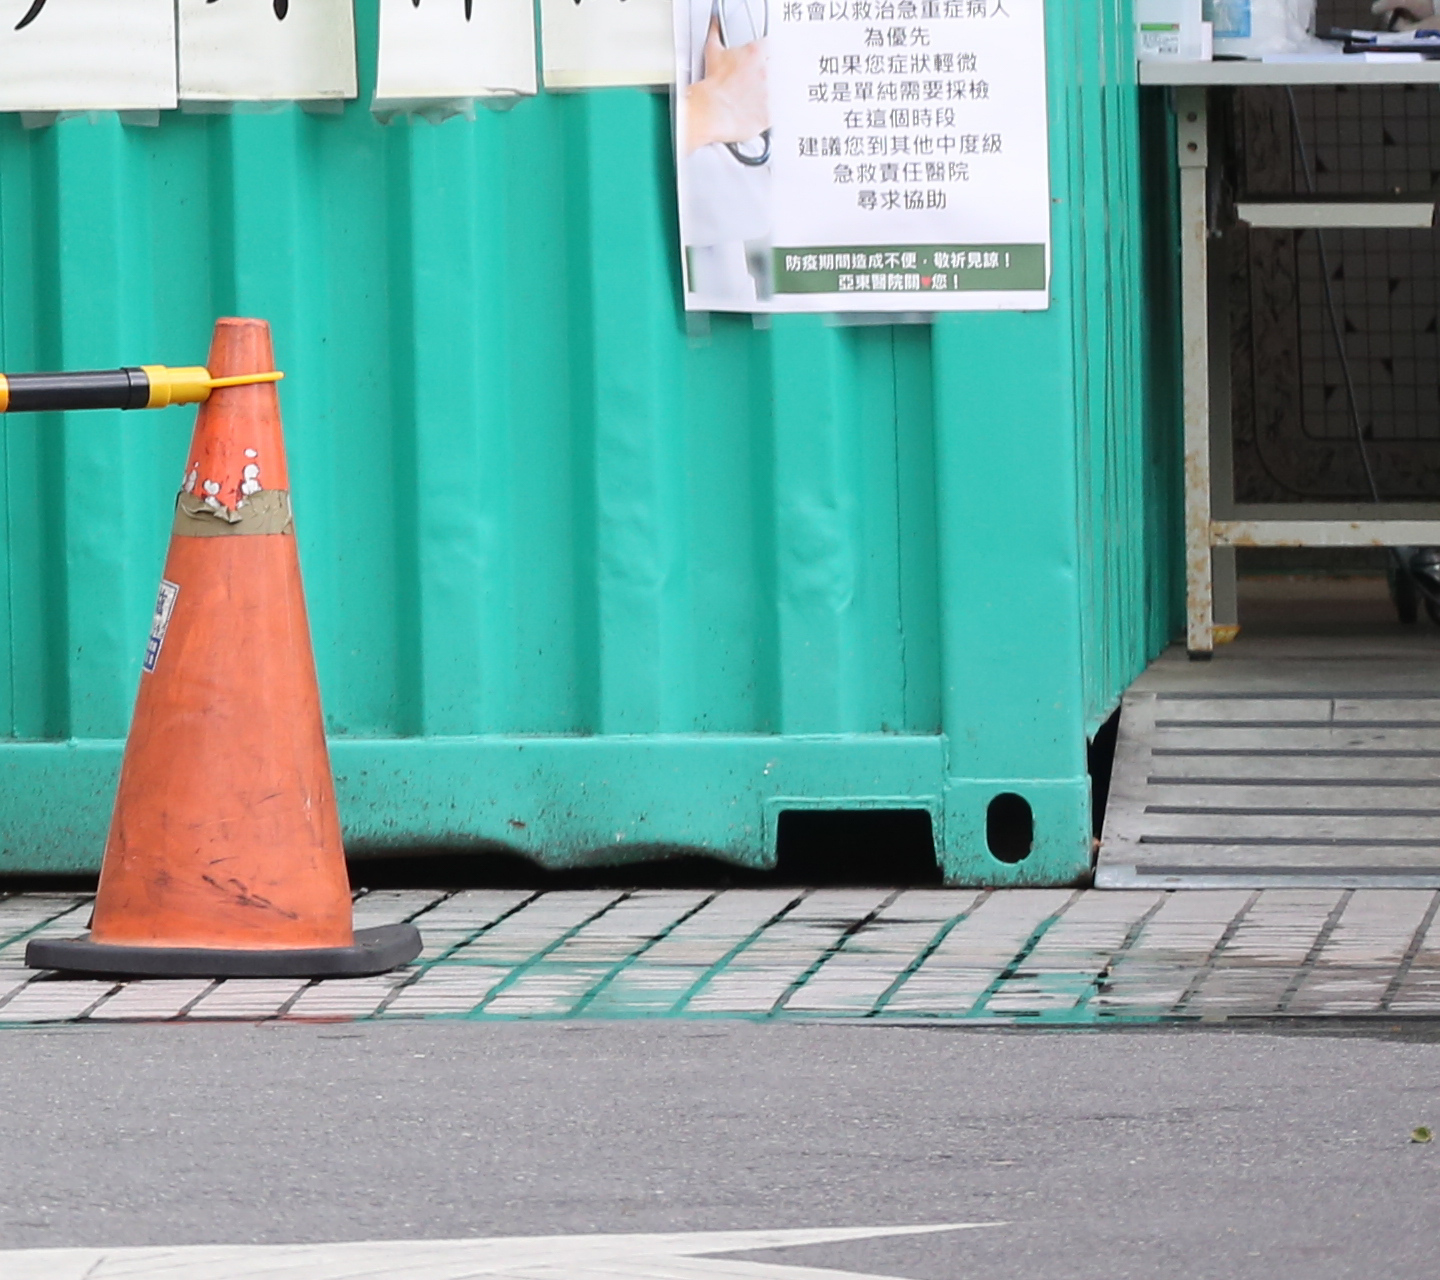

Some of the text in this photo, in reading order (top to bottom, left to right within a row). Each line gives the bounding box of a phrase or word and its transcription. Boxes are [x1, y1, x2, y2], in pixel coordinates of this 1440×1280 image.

[864, 26, 932, 47] 為優先
[818, 52, 978, 75] 如果您症狀輕微
[807, 78, 990, 102] 或是單純需要採檢
[843, 107, 957, 130] 在這個時段
[798, 133, 1004, 157] 建議您到其他中度級
[832, 161, 970, 184] 急救責任醫院
[856, 189, 947, 211] 尋求協助
